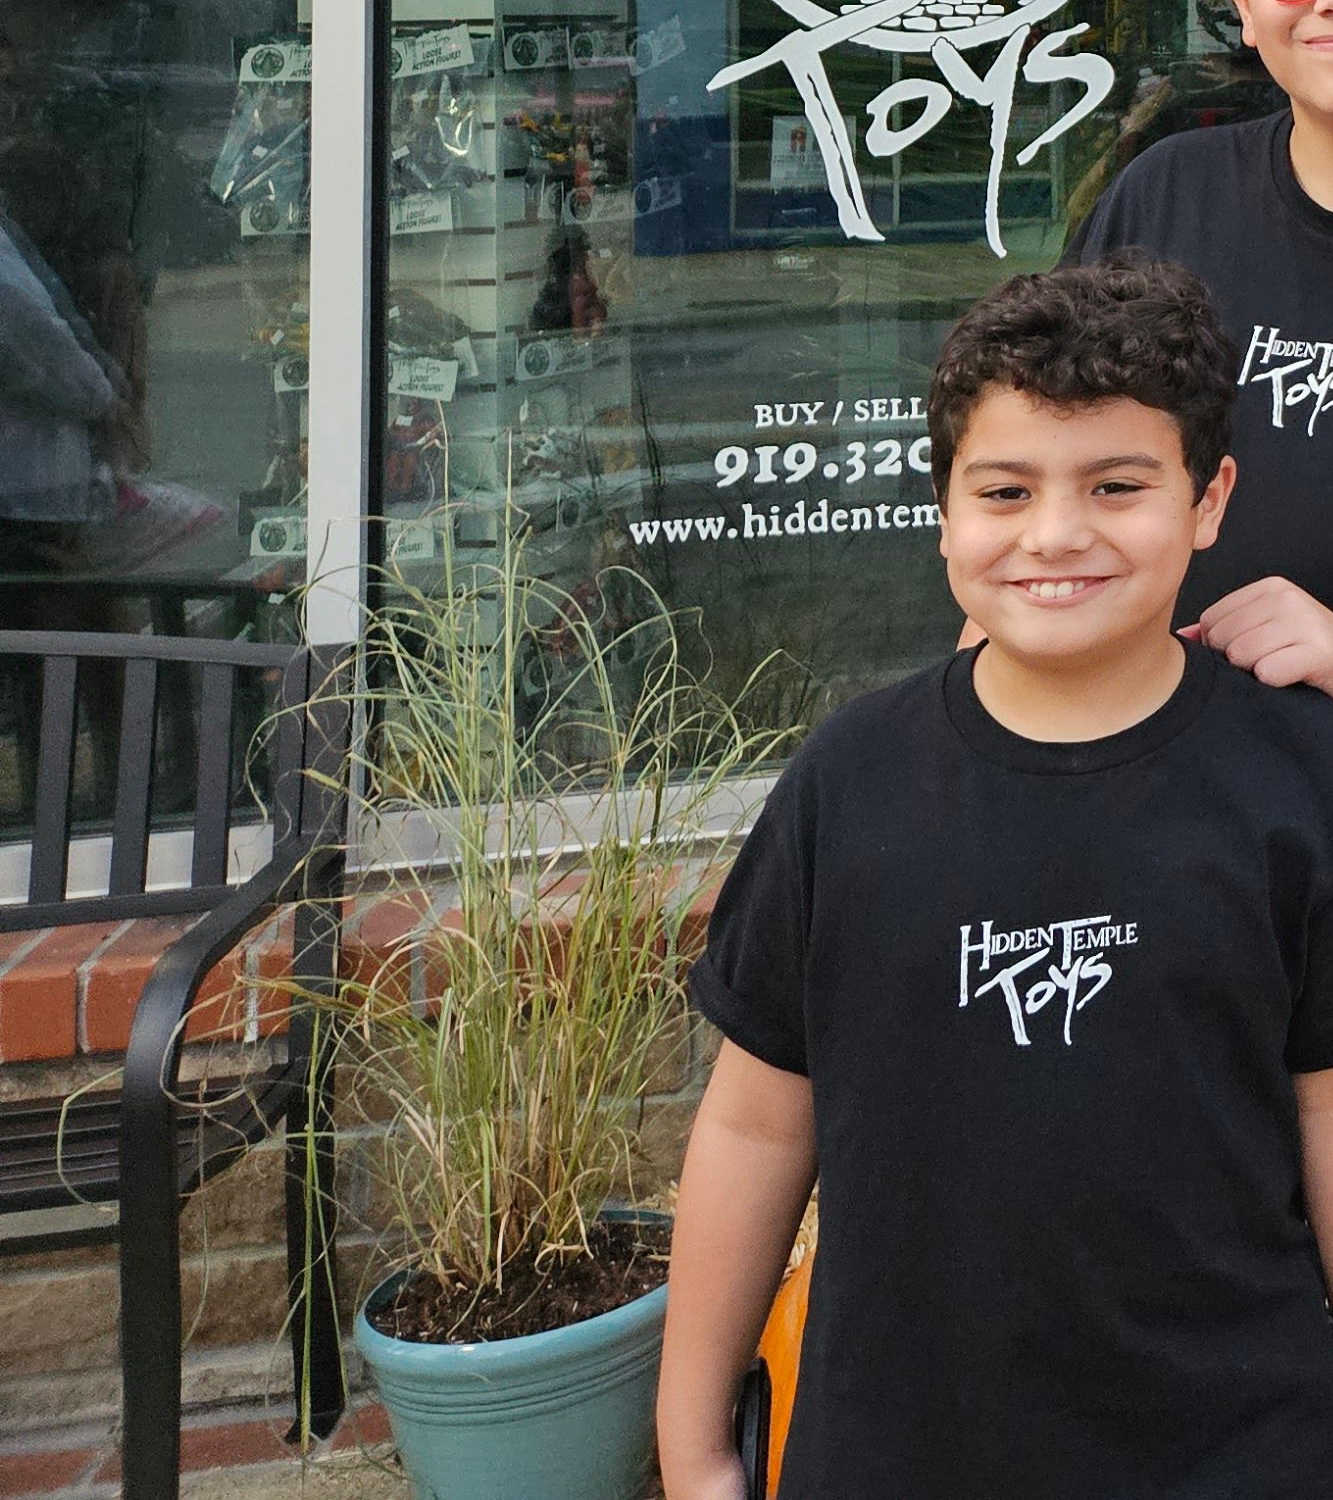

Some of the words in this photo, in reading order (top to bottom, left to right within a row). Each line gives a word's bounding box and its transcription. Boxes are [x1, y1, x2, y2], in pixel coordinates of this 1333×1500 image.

[754, 401, 824, 429] BUY
[832, 401, 844, 427] /
[854, 397, 928, 423] SELL
